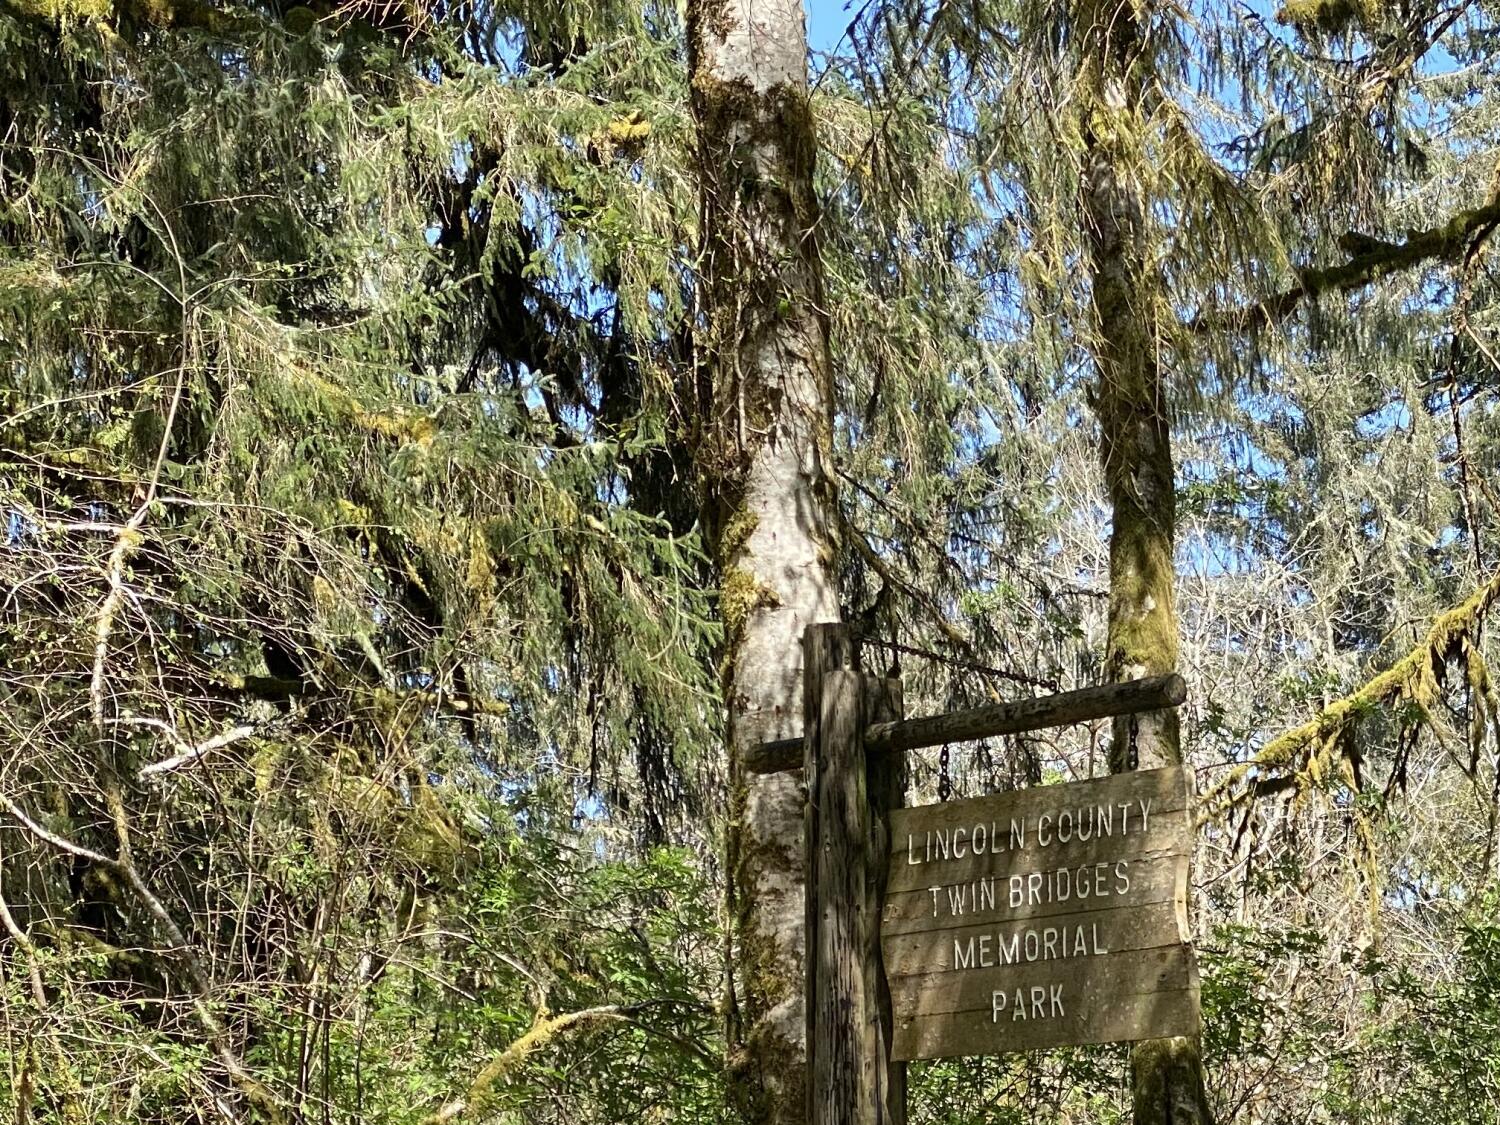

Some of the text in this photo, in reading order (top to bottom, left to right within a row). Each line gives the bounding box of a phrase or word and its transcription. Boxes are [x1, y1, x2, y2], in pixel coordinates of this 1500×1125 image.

[908, 798, 1151, 865] LINCOLN COUNTY
[928, 859, 1130, 917] TWIN BRIDGES
[953, 923, 1108, 970] MEMORIAL
[992, 984, 1065, 1023] PARK
